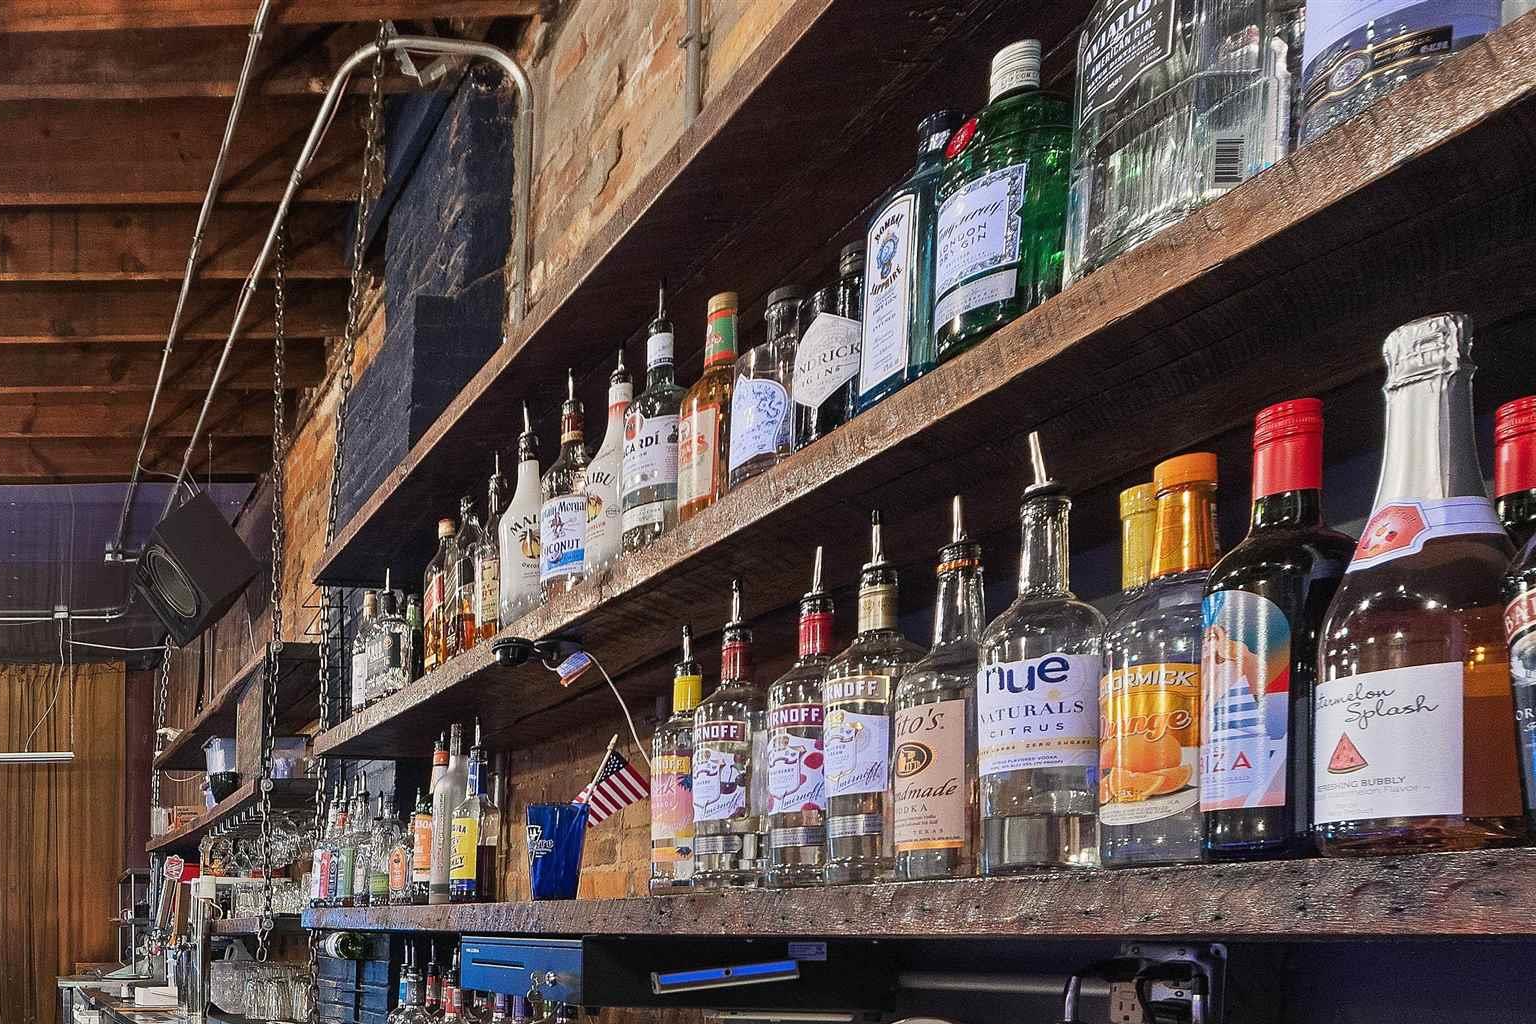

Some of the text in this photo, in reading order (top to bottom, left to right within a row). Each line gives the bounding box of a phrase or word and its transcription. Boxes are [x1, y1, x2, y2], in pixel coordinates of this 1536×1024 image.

[1085, 0, 1159, 70] AVIATIO
[1090, 33, 1131, 80] AMERICAN
[1134, 18, 1153, 38] GIN
[960, 231, 986, 249] GIN
[986, 656, 1070, 694] nue
[895, 706, 944, 738] ito's
[1344, 694, 1440, 730] Splash
[990, 722, 1064, 738] CITRUS
[1360, 776, 1406, 788] BUBBLY
